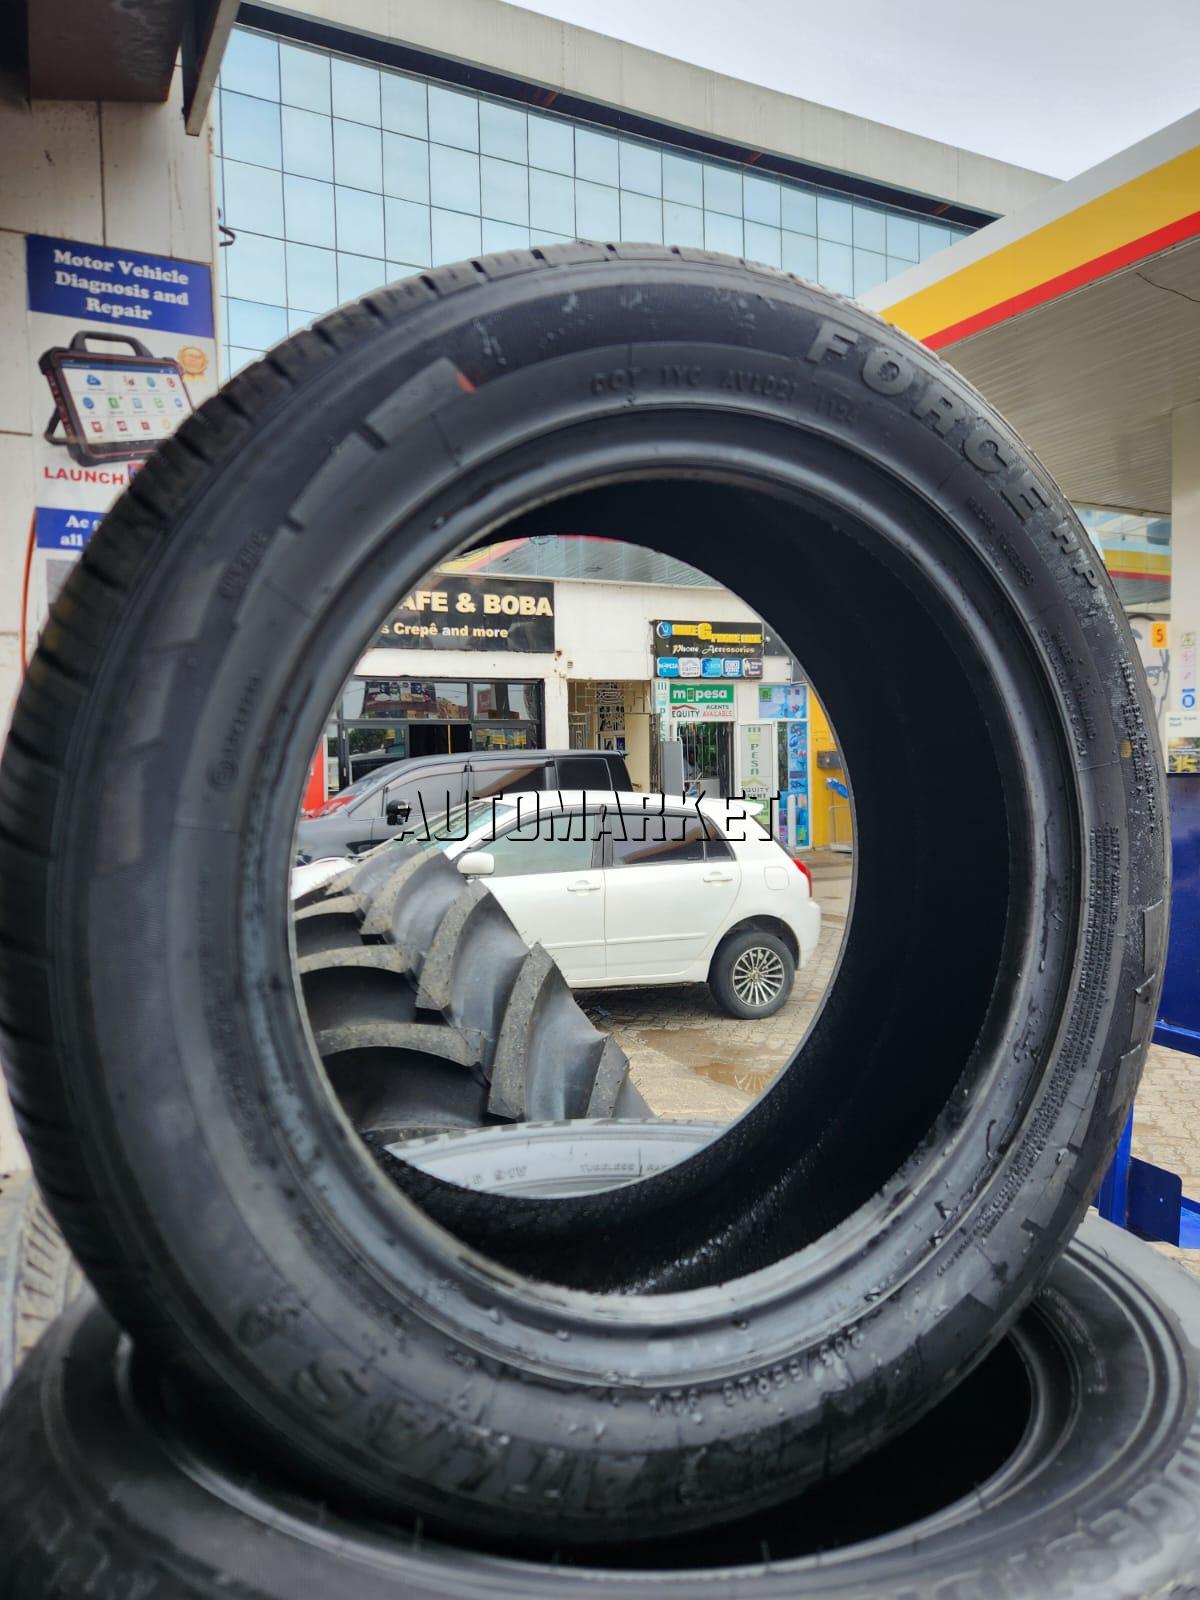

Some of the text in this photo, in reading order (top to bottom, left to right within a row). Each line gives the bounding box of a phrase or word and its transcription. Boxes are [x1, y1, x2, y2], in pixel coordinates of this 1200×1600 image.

[53, 249, 189, 285] Motor Vehicle
[54, 270, 189, 306] Diagnosis and
[85, 297, 152, 320] Repair
[803, 320, 1049, 522] FORCE
[44, 466, 124, 485] LAUNCH
[60, 533, 83, 547] all
[399, 590, 554, 617] AFE & BOBA
[394, 622, 438, 638] Crepê
[442, 625, 469, 637] and
[472, 628, 509, 638] more
[1156, 628, 1164, 643] 5
[672, 644, 699, 655] Phone
